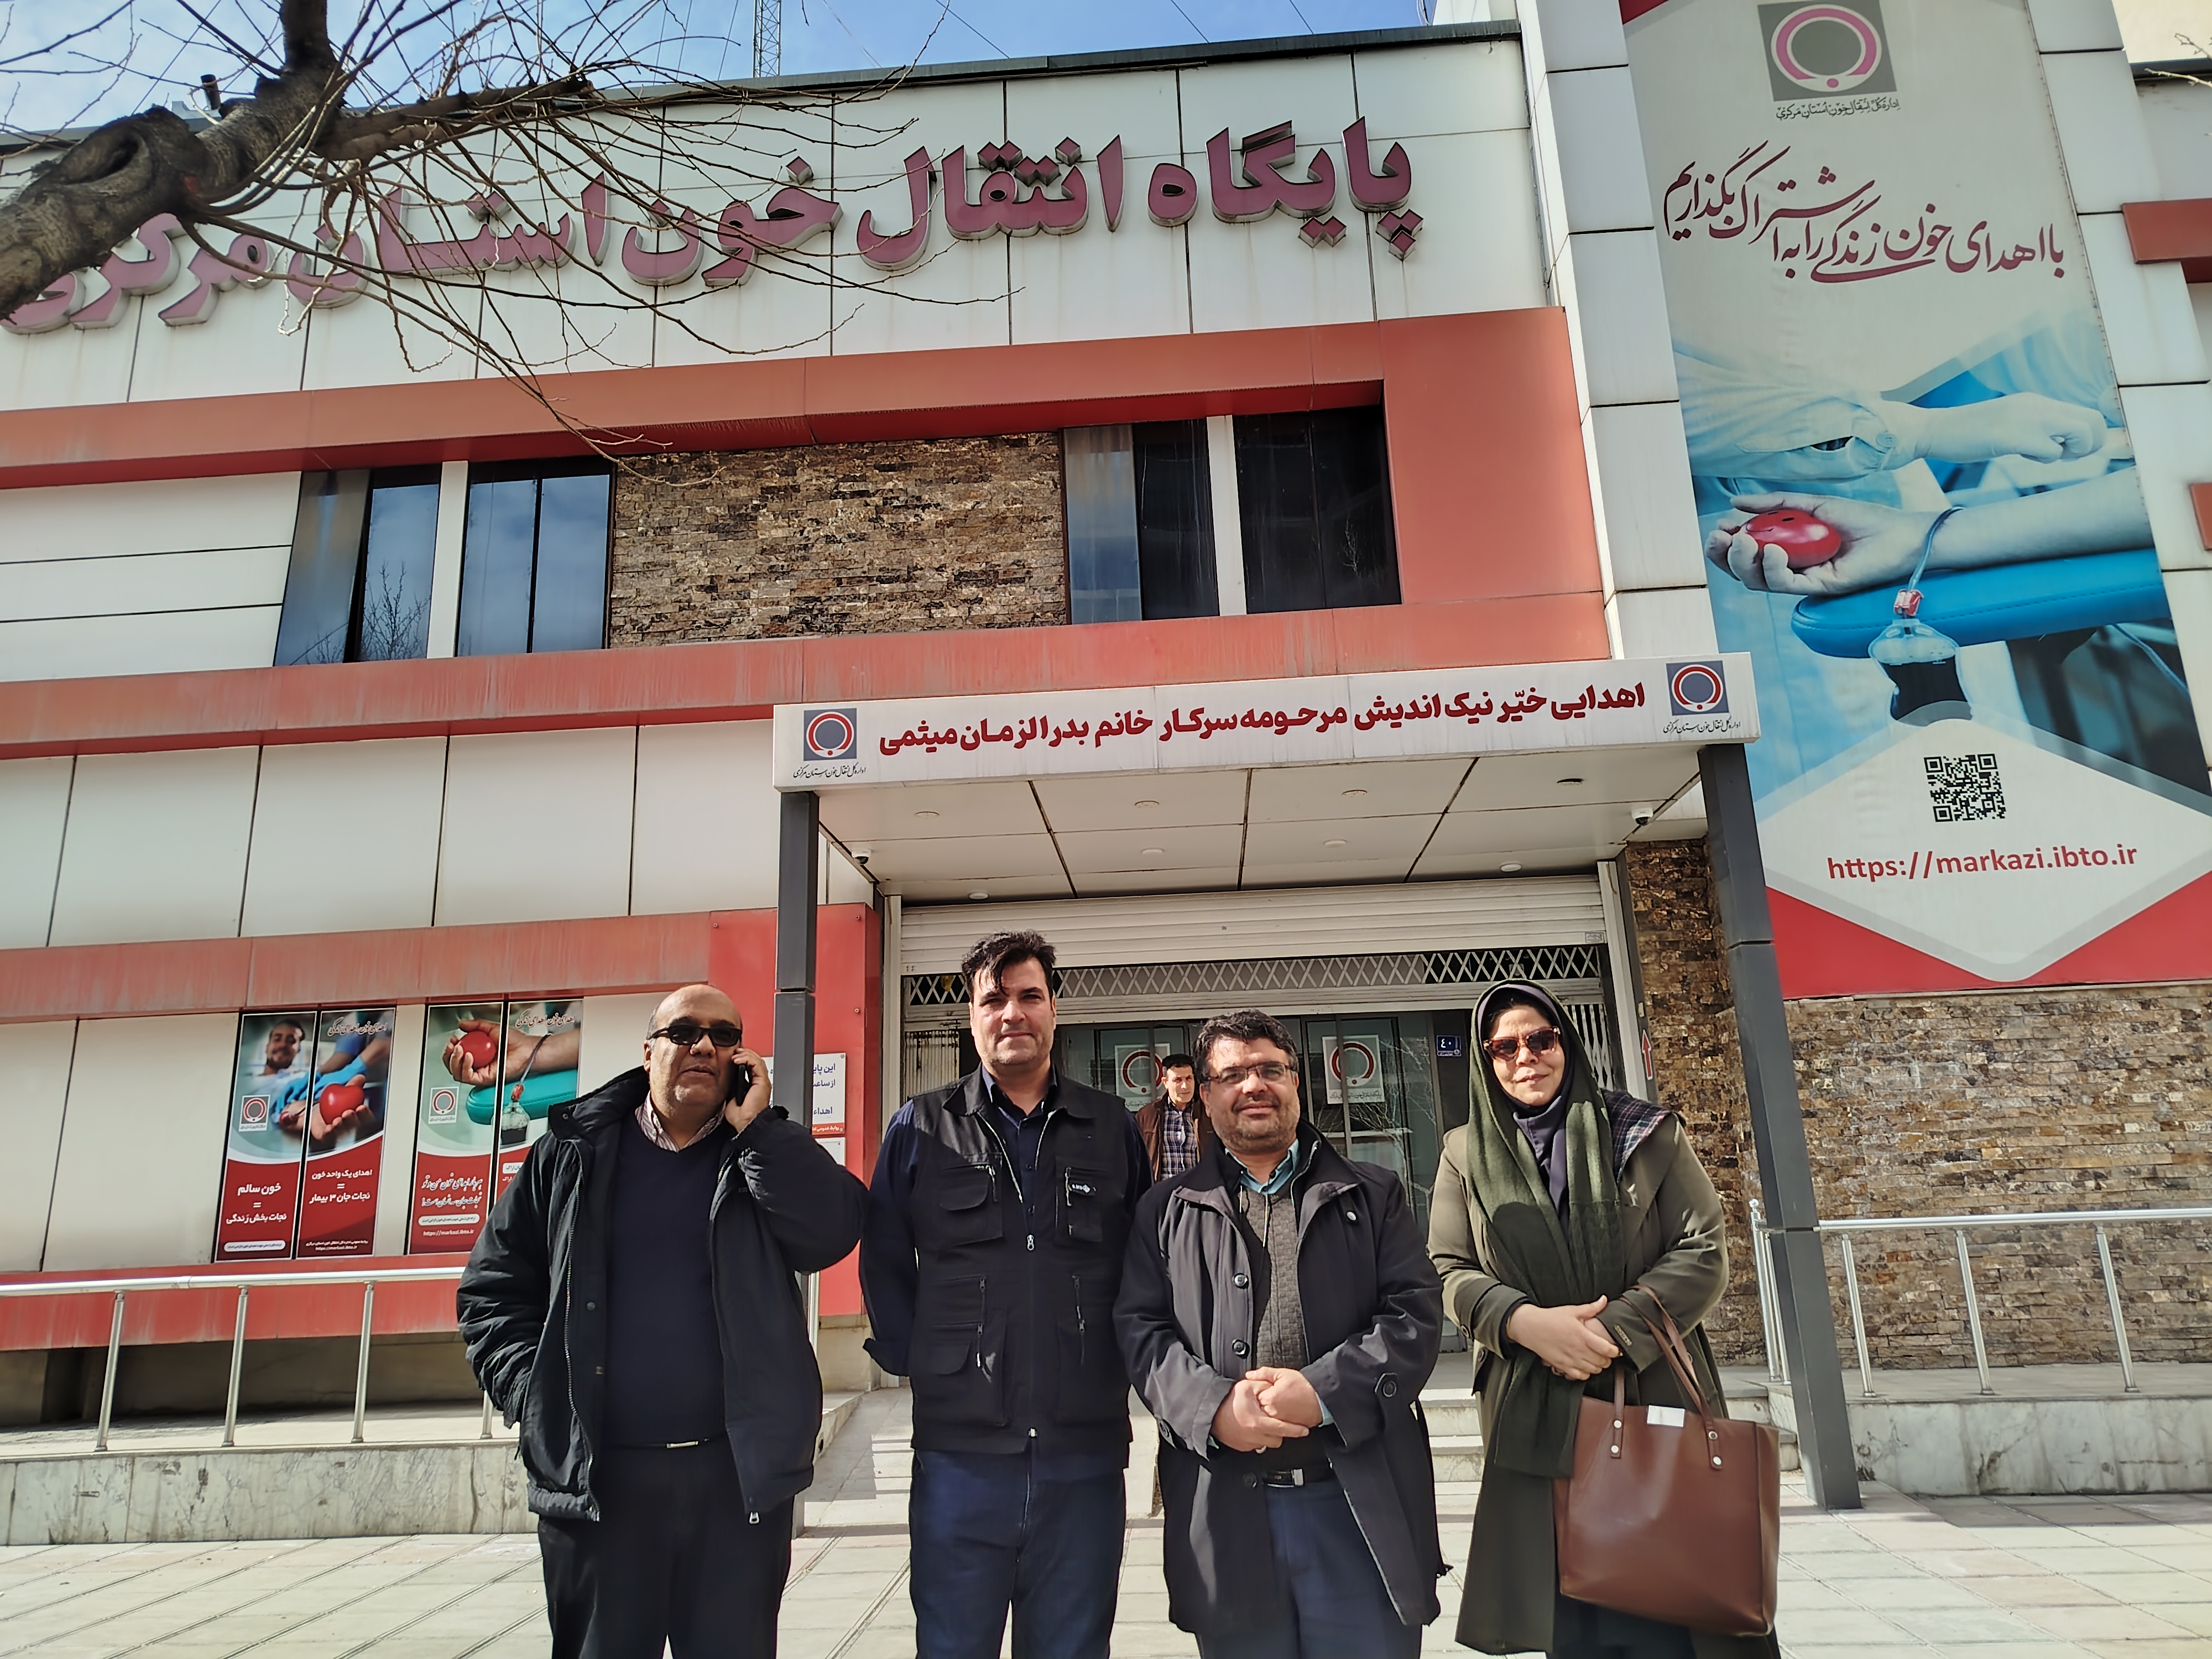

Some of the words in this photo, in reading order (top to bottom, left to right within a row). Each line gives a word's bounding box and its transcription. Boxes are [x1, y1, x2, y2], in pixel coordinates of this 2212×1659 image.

[1147, 116, 1425, 262] پایگاه
[1663, 140, 1768, 241] بگذاریم
[857, 134, 1125, 270] انتقال
[1709, 145, 1875, 262] اشتراک
[622, 156, 844, 286] خون
[285, 171, 611, 309] استان
[1806, 220, 1824, 260] را
[1811, 195, 1936, 283] زندگی
[1884, 203, 1952, 261] خون
[1945, 221, 2045, 273] اهدای
[2048, 223, 2064, 278] با
[1781, 244, 1800, 279] به
[1444, 691, 1493, 724] نیک
[1551, 681, 1645, 720] اهدایی
[1354, 692, 1441, 731] اندیش
[1094, 709, 1154, 748] خانم
[1159, 707, 1238, 742] سرکار
[1240, 706, 1348, 735] مرحومه
[1663, 719, 1679, 734] مرکزی
[1676, 723, 1699, 733] استان
[1698, 721, 1710, 732] خون
[1708, 719, 1723, 732] انتقال
[1721, 715, 1731, 732] کل
[880, 720, 958, 756] میثمی
[793, 764, 810, 778] مرکزی
[805, 768, 828, 778] استان
[826, 766, 837, 778] خون
[835, 765, 850, 777] انتقال
[847, 761, 859, 777] کل
[1827, 844, 2137, 882] https://markazi.ibto.ir
[823, 1063, 836, 1073] این
[830, 1079, 836, 1088] از
[311, 1171, 326, 1180] خون
[341, 1170, 352, 1178] یک
[352, 1169, 372, 1178] اهدای
[237, 1183, 261, 1196] سالم
[261, 1182, 281, 1195] خون
[309, 1193, 328, 1204] بیمار
[336, 1192, 351, 1203] جان
[352, 1192, 371, 1202] نجات
[226, 1213, 249, 1224] زندگی
[249, 1213, 268, 1223] بخش
[268, 1213, 287, 1223] نجات
